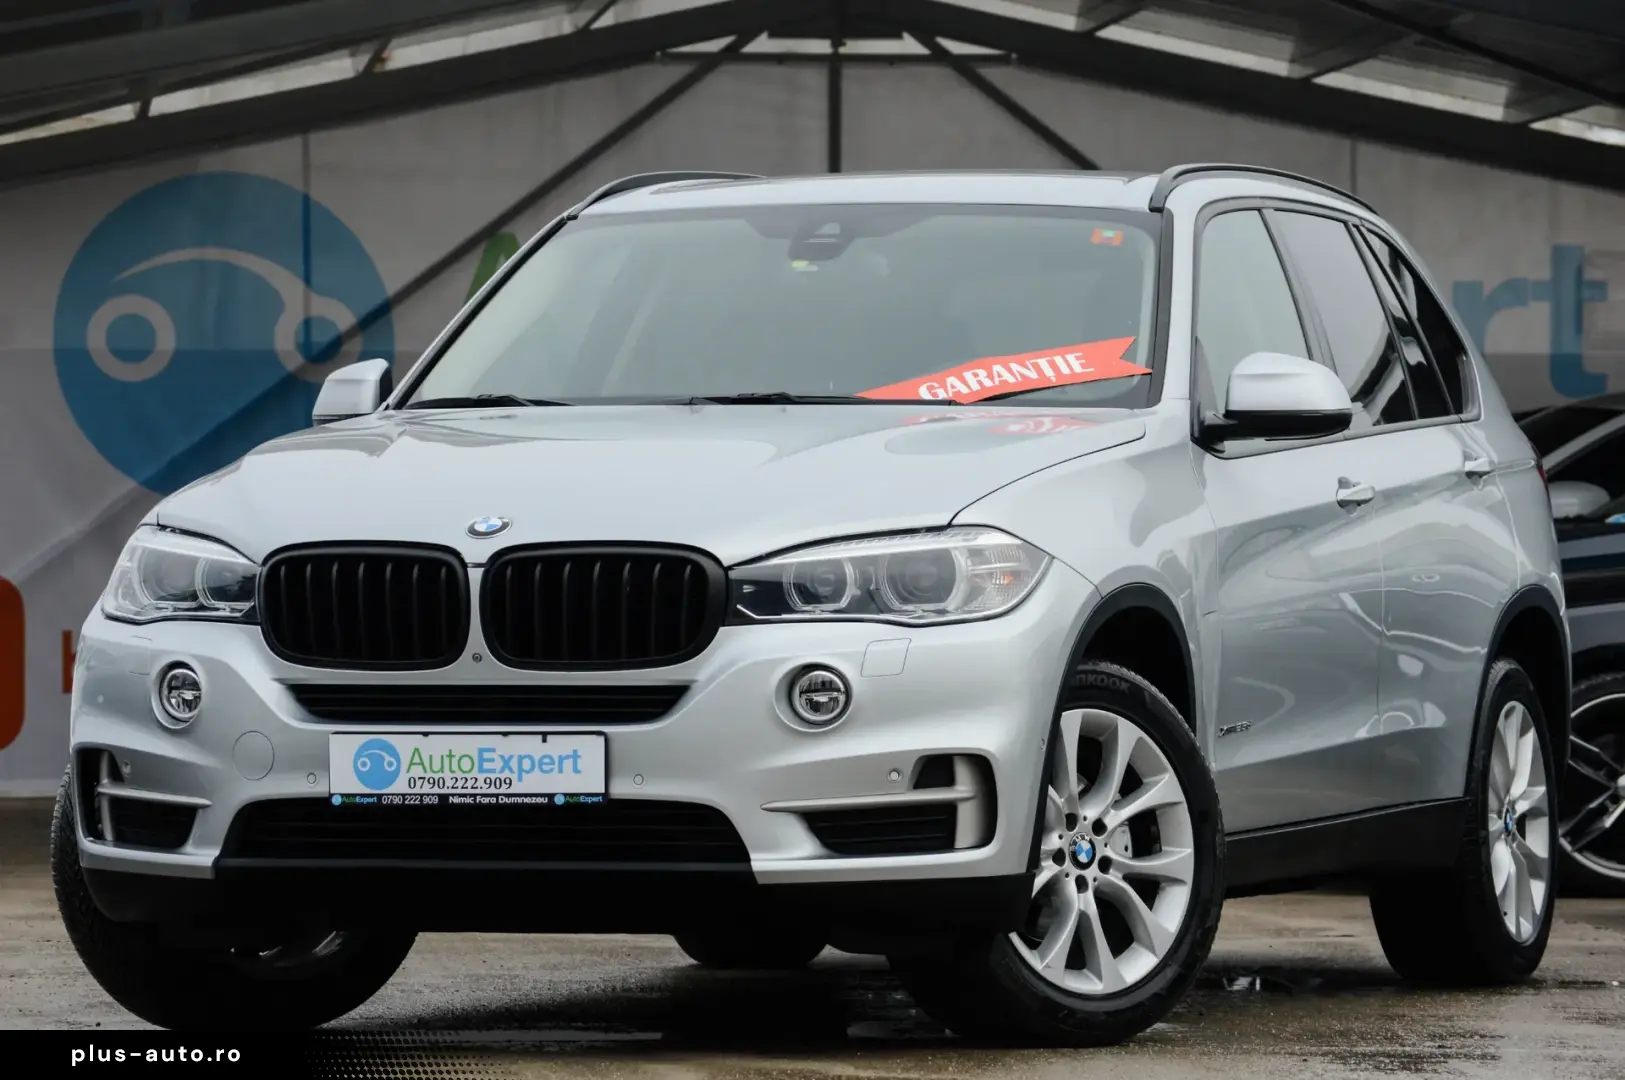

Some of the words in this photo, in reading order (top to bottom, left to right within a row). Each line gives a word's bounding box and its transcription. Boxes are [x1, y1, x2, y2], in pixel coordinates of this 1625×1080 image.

[917, 352, 1094, 400] GARANȚIE
[406, 747, 582, 782] AutoExpert
[407, 776, 513, 790] 0790.222.909
[342, 795, 377, 804] AutoExpert
[381, 795, 403, 804] 0790
[404, 795, 421, 804] 222
[422, 795, 439, 804] 909
[449, 795, 475, 804] Nimic
[476, 795, 497, 804] Fara
[499, 795, 549, 804] Dumnezeu
[565, 795, 603, 804] AutoExpert
